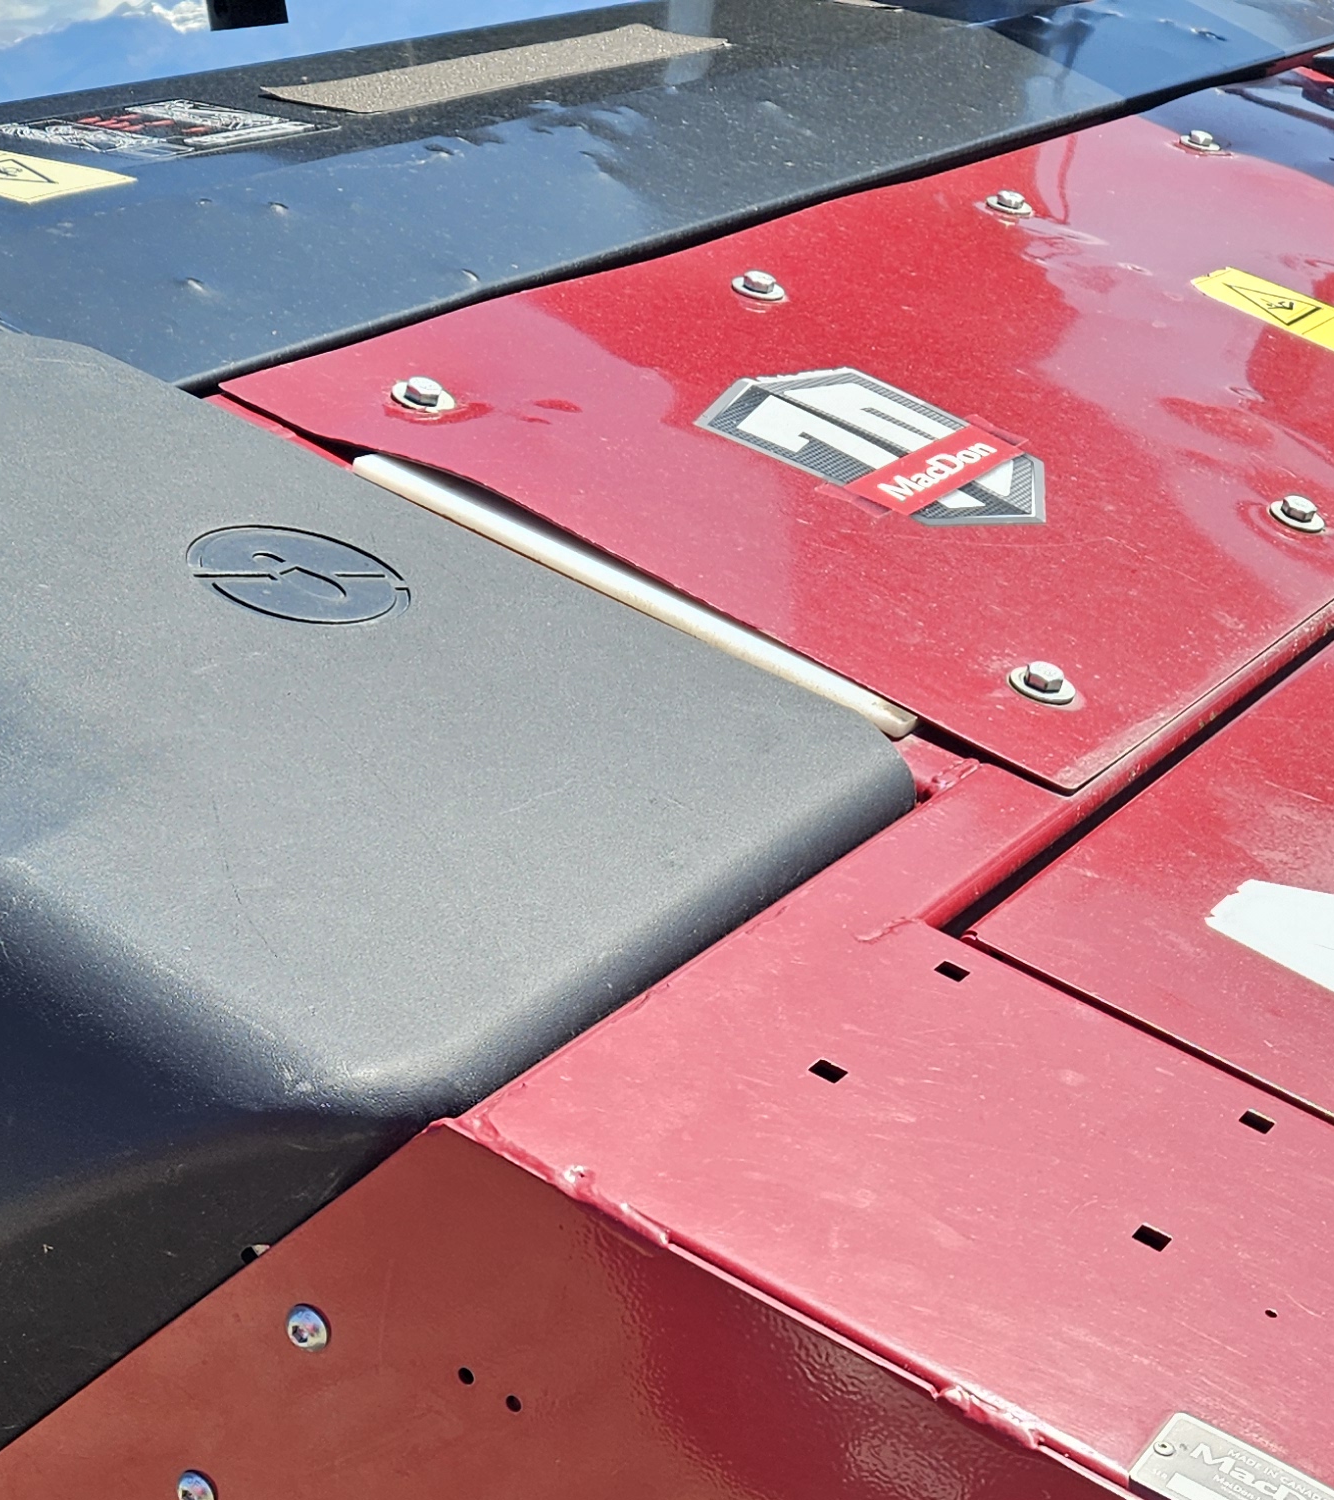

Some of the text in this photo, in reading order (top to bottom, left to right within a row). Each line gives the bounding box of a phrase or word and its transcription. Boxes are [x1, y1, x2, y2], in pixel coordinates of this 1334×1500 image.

[877, 440, 998, 503] MacDon
[1227, 1448, 1262, 1472] MADE
[1262, 1465, 1280, 1479] IN
[1212, 1473, 1254, 1500] MacDon
